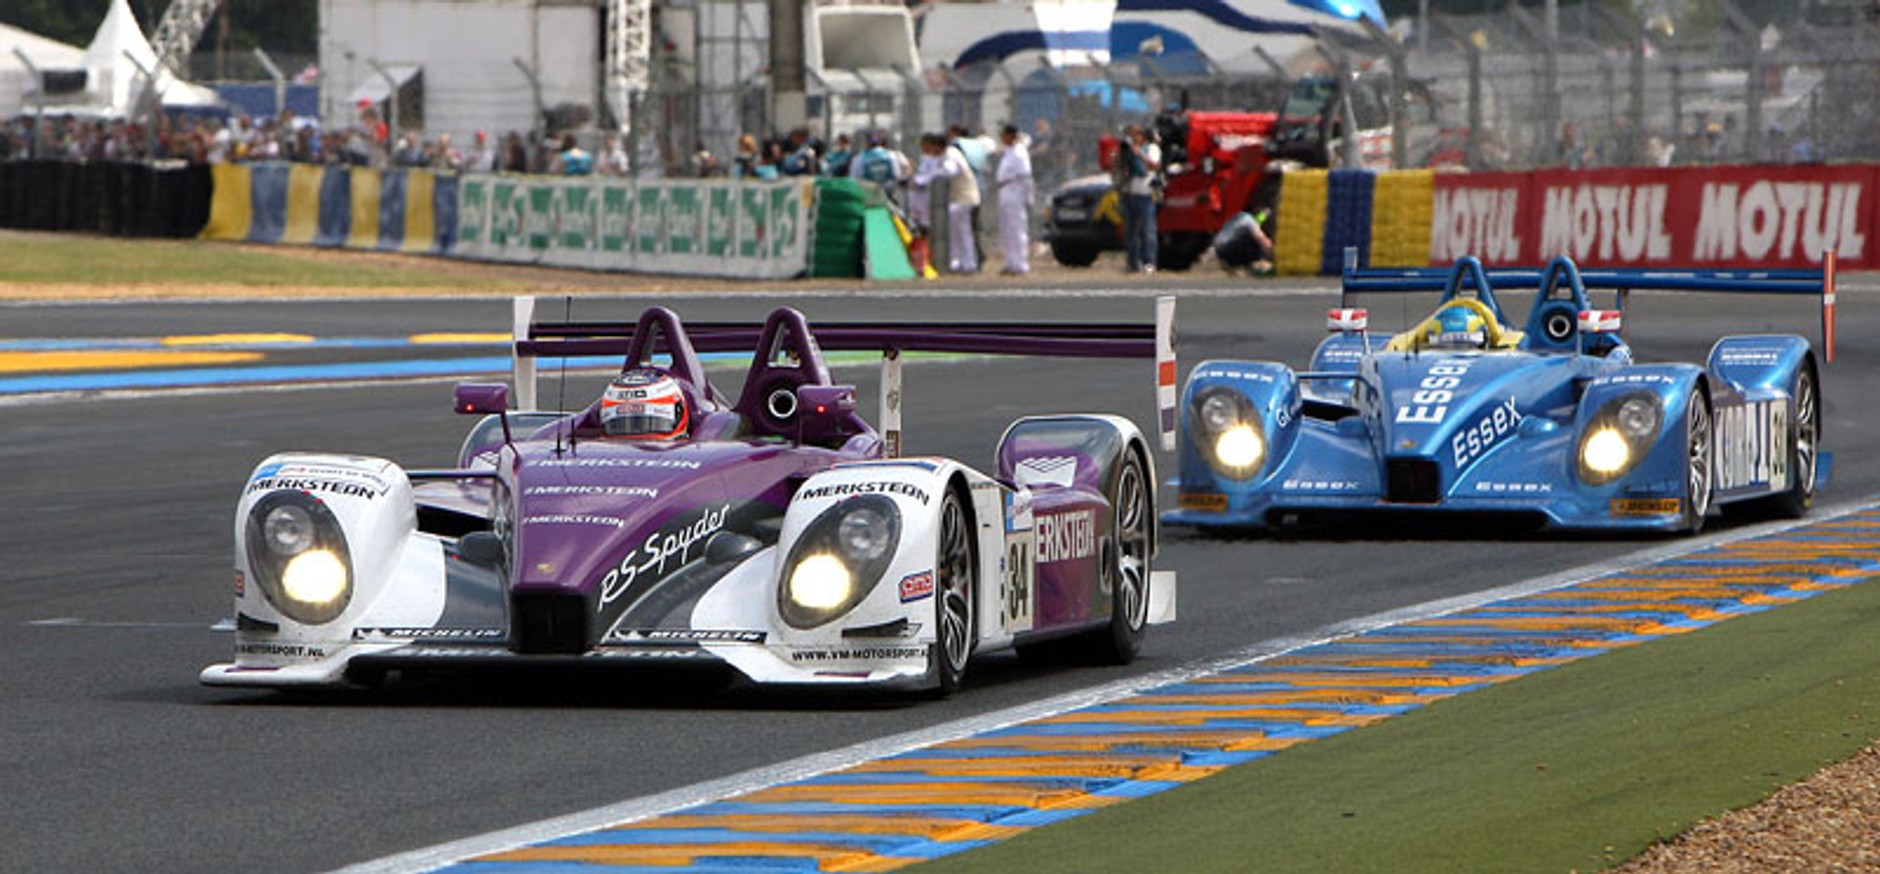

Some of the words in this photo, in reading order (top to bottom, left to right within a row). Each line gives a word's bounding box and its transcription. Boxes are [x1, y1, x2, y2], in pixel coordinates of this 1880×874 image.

[1431, 188, 1520, 261] MOTUL
[1540, 184, 1671, 261] MOTUL
[1693, 180, 1866, 261] MOTUL
[637, 503, 730, 575] Spyder
[1009, 543, 1028, 620] 34
[391, 628, 502, 640] MICHELIN
[649, 630, 761, 642] MICHELIN
